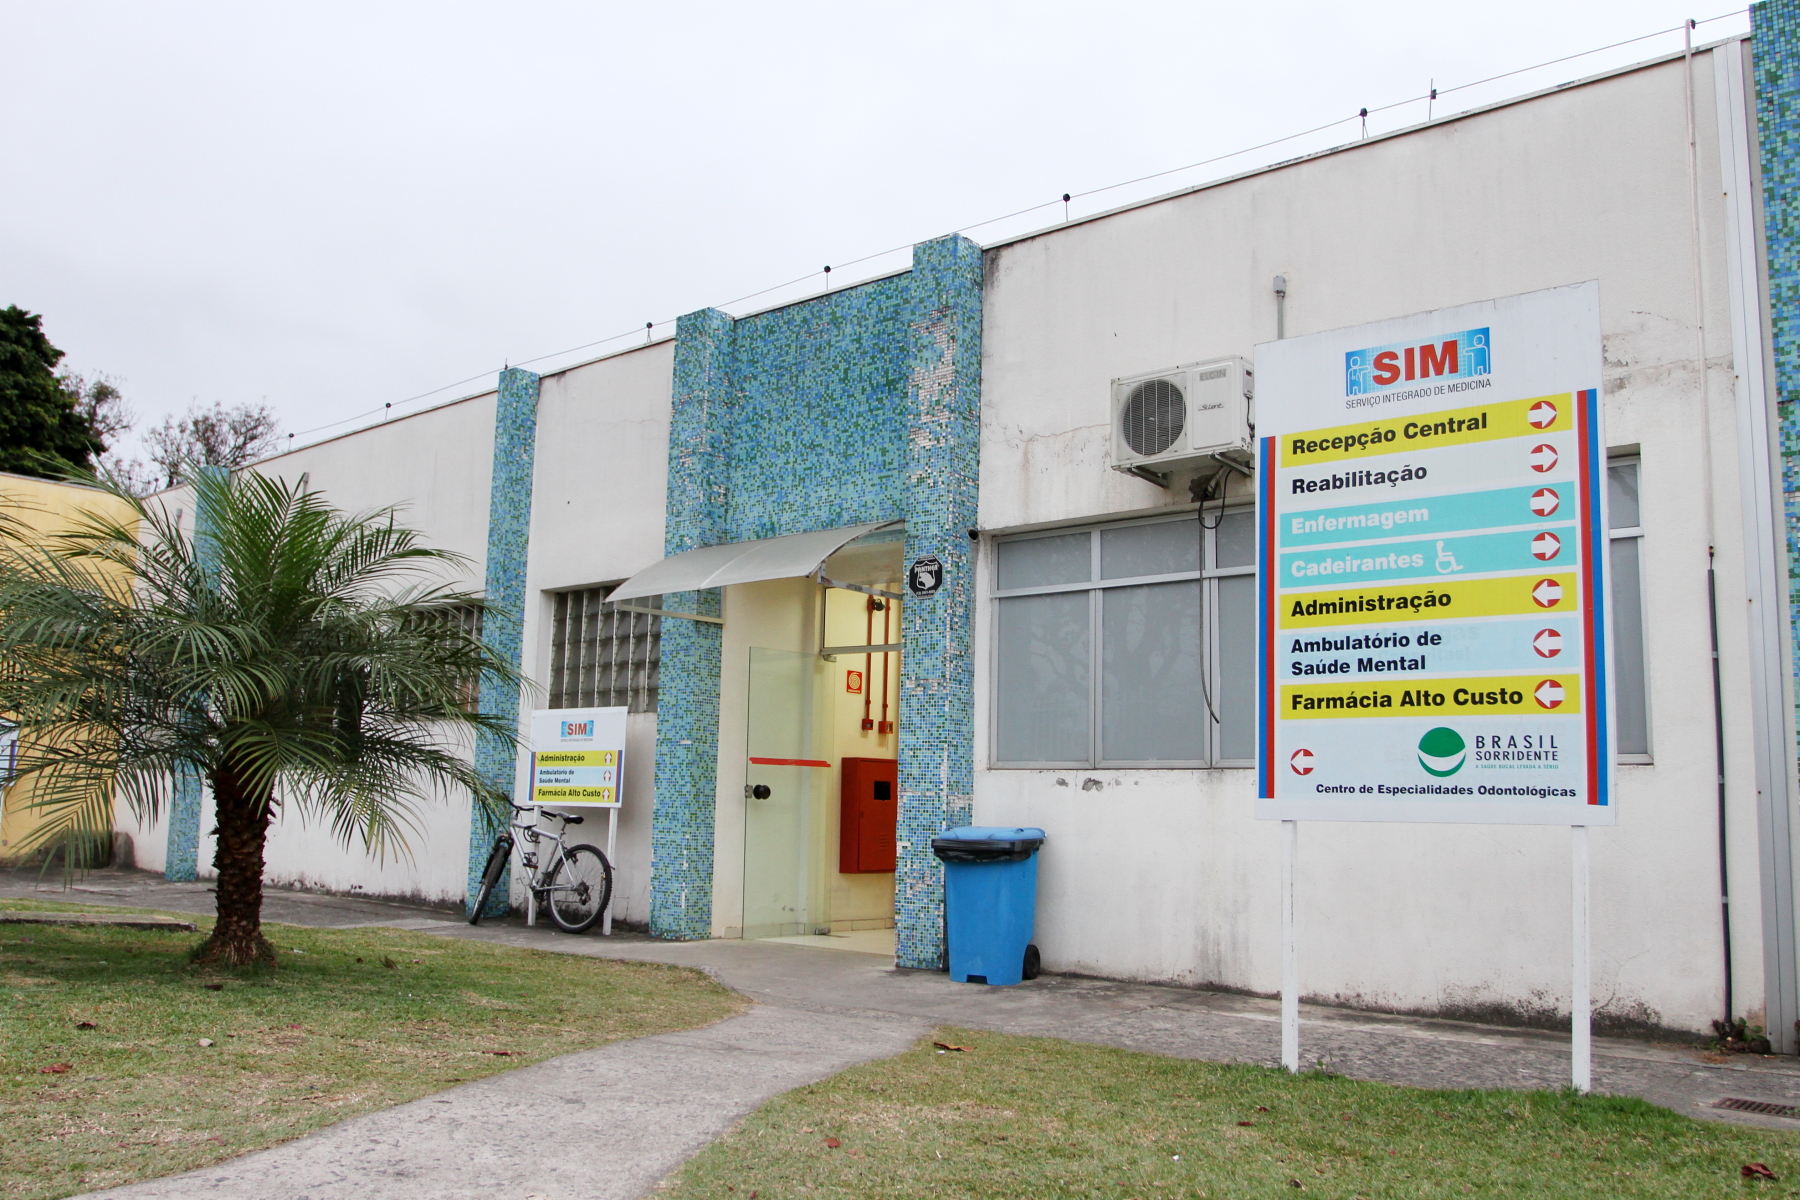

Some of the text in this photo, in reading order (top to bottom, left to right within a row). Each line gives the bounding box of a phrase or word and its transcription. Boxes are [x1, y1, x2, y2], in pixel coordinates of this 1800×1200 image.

[1372, 340, 1459, 385] SIM
[1199, 369, 1227, 381] ELGIN
[1345, 379, 1492, 410] SERVIÇO INTEGRADO DE MEDICINA
[1292, 412, 1488, 455] Recepção Central
[1291, 464, 1428, 495] Reabilitação
[1291, 507, 1429, 534] Enfermagem
[1290, 552, 1424, 577] Cadeirantes
[1290, 590, 1452, 617] Administração
[1290, 633, 1410, 653] Ambulatório
[1416, 631, 1442, 646] de
[1291, 659, 1351, 676] Saúde
[1357, 655, 1426, 673] Mental
[1291, 687, 1524, 711] Farmácia Alto Custo
[567, 723, 587, 735] SIM
[1475, 735, 1558, 749] BRASIL
[540, 754, 585, 763] Administração
[1475, 750, 1558, 761] SORRIDENTE
[538, 789, 601, 797] Farmácia Alto Custo
[1316, 784, 1577, 799] Centro de Especialidades Odontológicas
